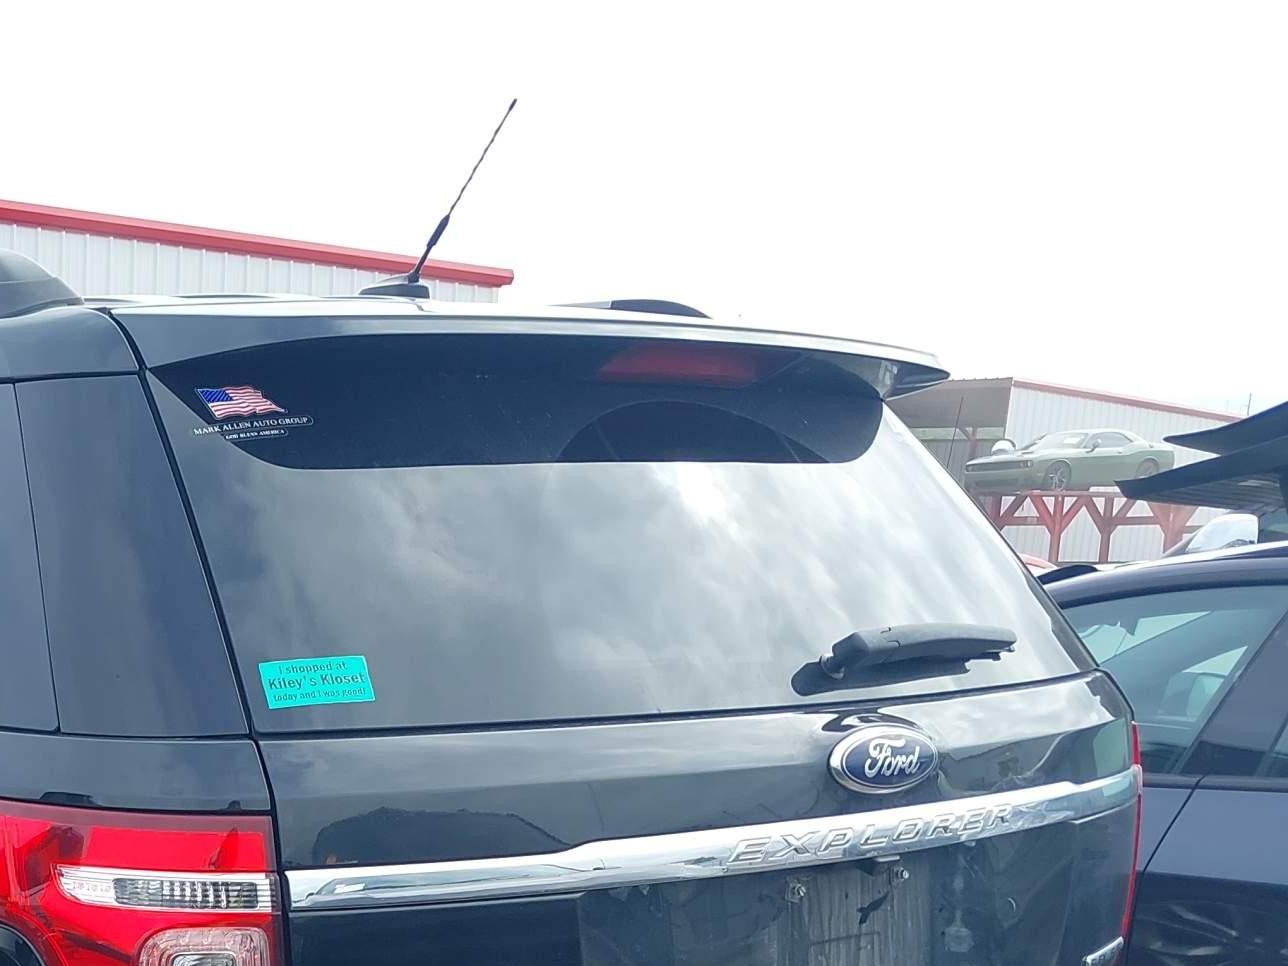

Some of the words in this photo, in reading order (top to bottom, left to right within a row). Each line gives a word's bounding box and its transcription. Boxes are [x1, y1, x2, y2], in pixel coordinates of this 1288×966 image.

[193, 425, 222, 435] MARK
[222, 421, 252, 431] ALLEN
[253, 418, 278, 427] AUTO
[278, 416, 309, 425] GROUP
[285, 661, 332, 673] shopped
[335, 660, 348, 670] at
[268, 675, 318, 691] Kiley's
[319, 671, 367, 686] Kloset
[273, 693, 298, 703] today
[300, 689, 316, 700] and
[324, 688, 341, 698] was
[864, 738, 921, 779] Ford
[726, 803, 1013, 864] EXPLORER
